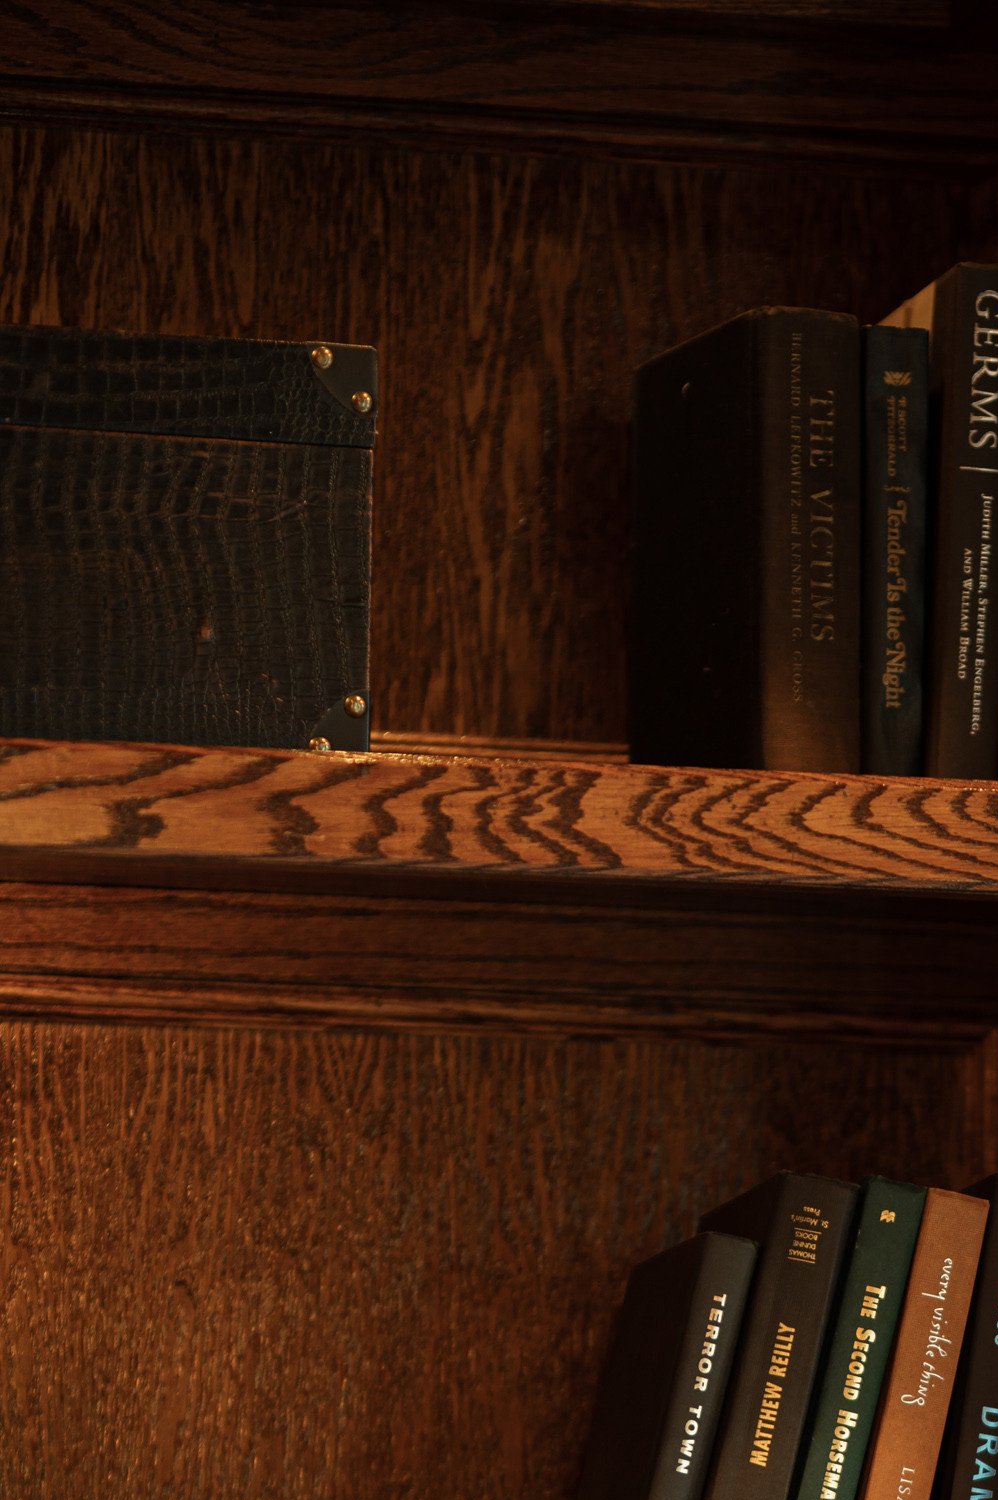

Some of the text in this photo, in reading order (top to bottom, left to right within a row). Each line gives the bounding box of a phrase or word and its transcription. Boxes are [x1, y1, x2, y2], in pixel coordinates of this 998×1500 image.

[791, 333, 803, 407] BERNARD
[791, 413, 803, 507] LEFKOWITZ
[792, 512, 803, 535] and
[810, 390, 835, 641] THE VICTIMS
[887, 500, 908, 576] Tender
[791, 541, 803, 620] KENNETH
[957, 547, 974, 680] AND WILLIAM BROAD
[969, 493, 994, 736] JUDITH MILLER, STEPHEN ENGELBERG,
[887, 603, 902, 642] the
[793, 649, 804, 702] GROSS
[883, 641, 908, 709] Night
[791, 1214, 819, 1226] Martin's
[793, 1240, 817, 1251] DUNNE
[795, 1231, 819, 1241] BOOKS
[803, 1205, 821, 1217] Press
[789, 1248, 816, 1260] THOMAS
[860, 1285, 887, 1320] THE
[901, 1256, 954, 1406] every visible thing
[675, 1293, 727, 1475] TERROR TOWN
[749, 1321, 797, 1468] MATTHEW REILLY
[843, 1326, 878, 1401] SECOND
